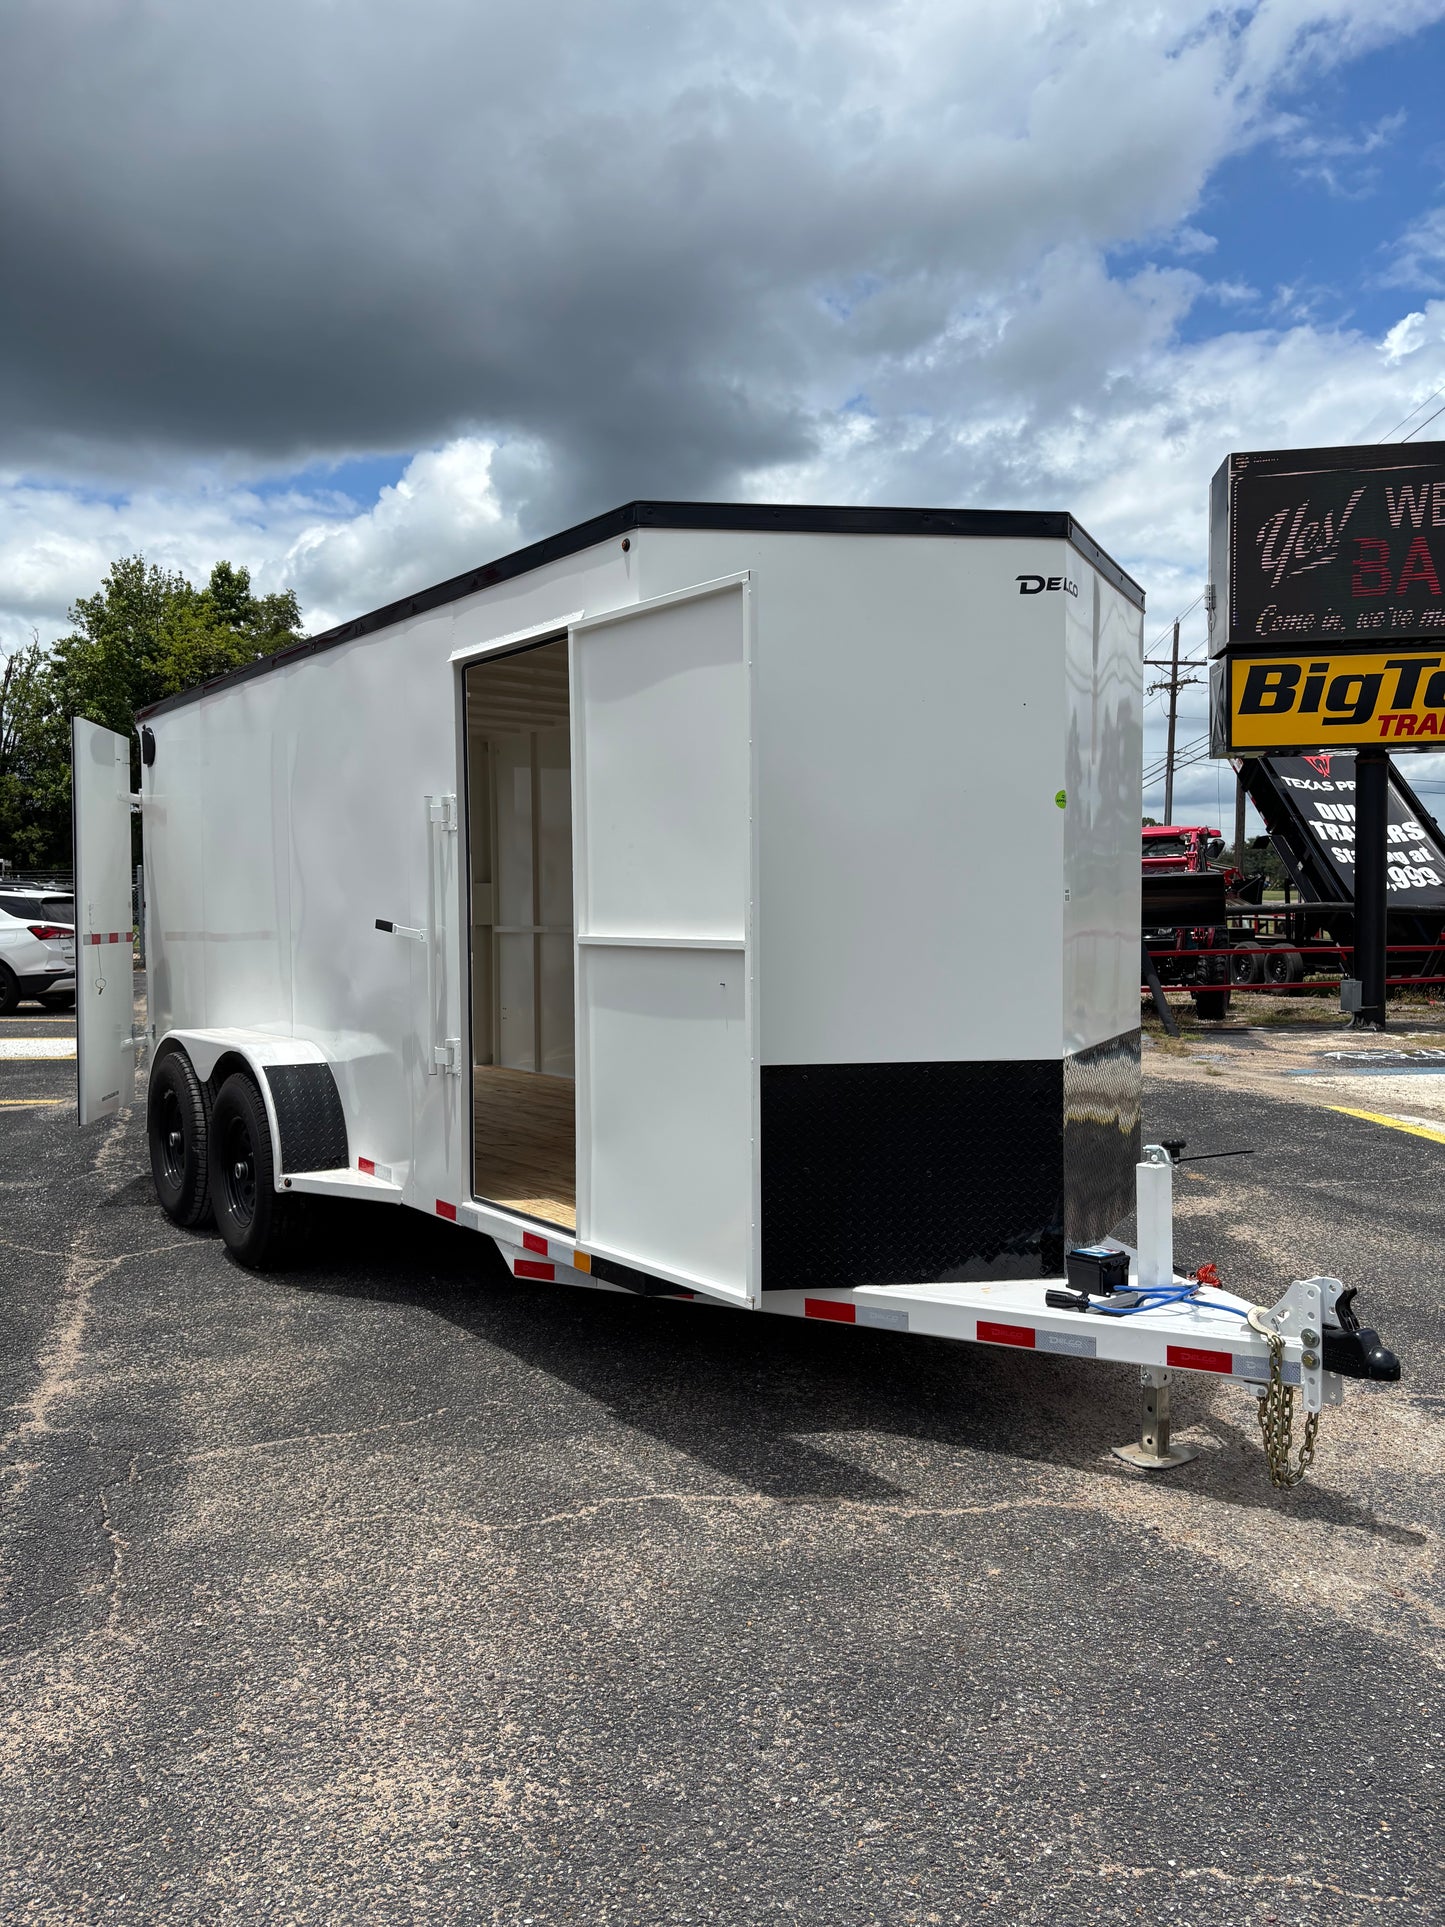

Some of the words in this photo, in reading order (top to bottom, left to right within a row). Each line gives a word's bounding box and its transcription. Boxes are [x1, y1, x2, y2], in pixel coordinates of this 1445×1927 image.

[1015, 575, 1079, 598] DELCO
[1255, 604, 1316, 636] Come
[1281, 776, 1334, 792] TEXAS
[1409, 847, 1434, 863] at
